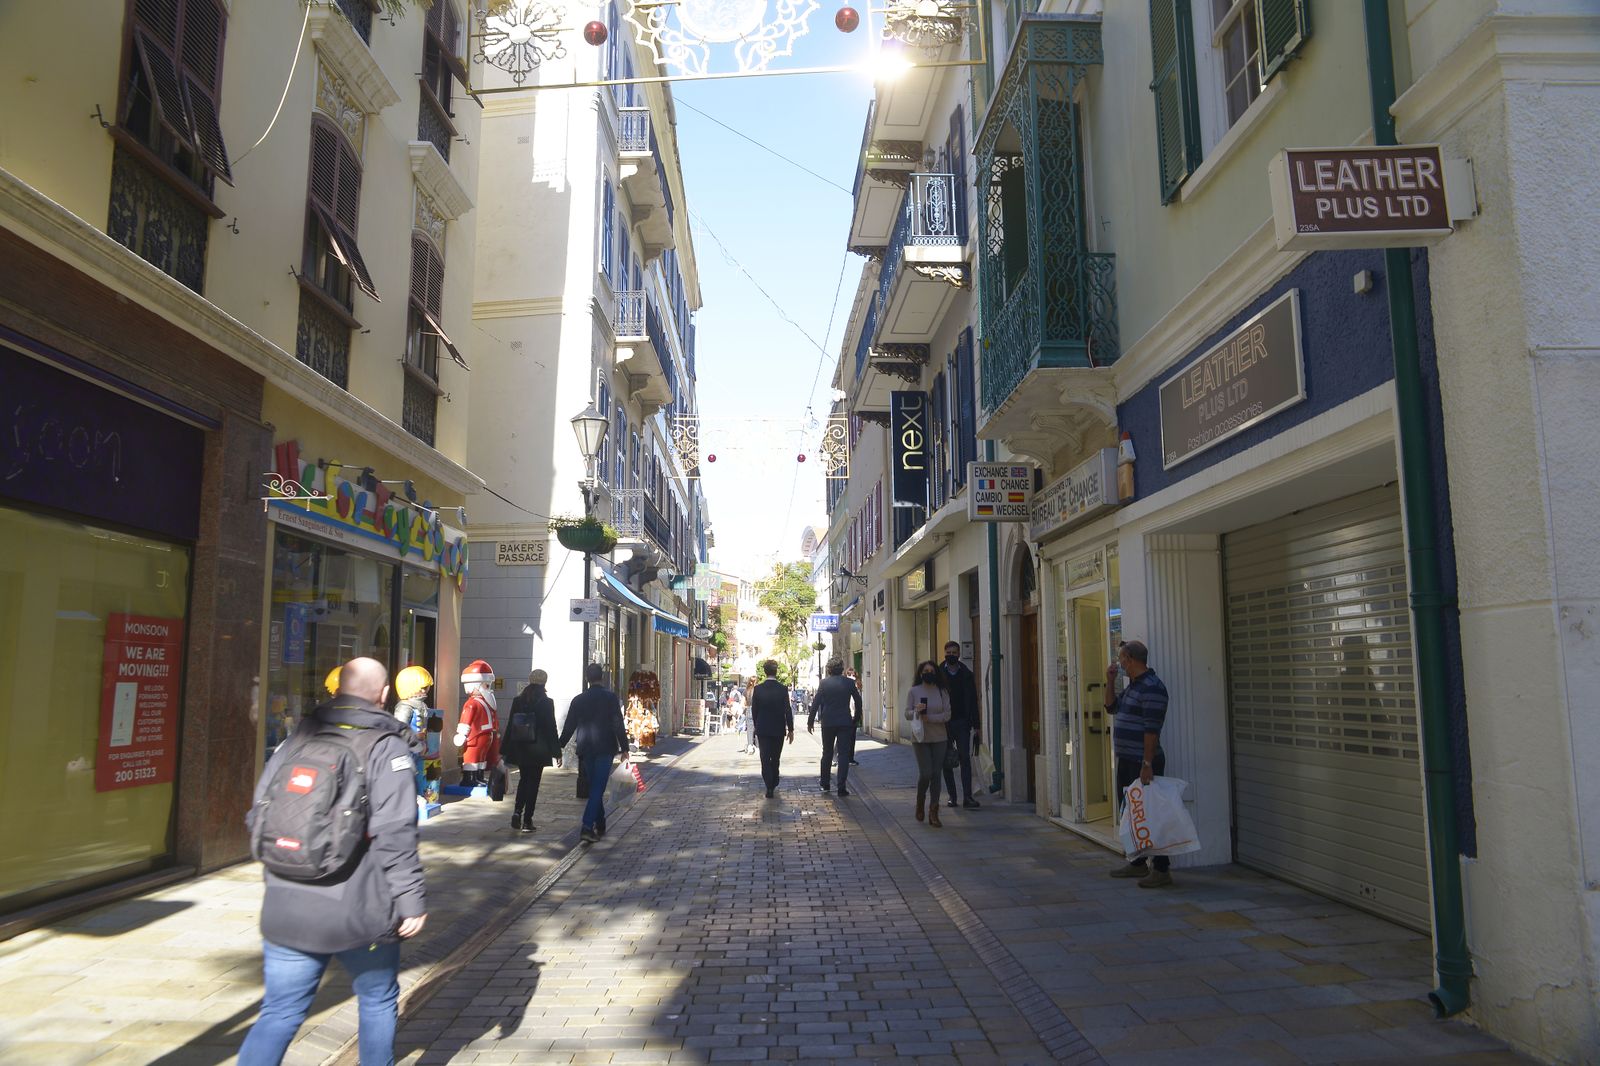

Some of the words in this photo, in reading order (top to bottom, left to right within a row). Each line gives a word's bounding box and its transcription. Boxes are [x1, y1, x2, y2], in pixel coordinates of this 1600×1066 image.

[1296, 157, 1440, 192] LEATHER
[1316, 197, 1379, 219] PLUS
[1385, 195, 1430, 218] LTD
[1300, 224, 1320, 232] 235A
[1181, 323, 1268, 409] LEATHER
[1199, 391, 1225, 424] PLUS
[1227, 378, 1249, 407] LTD
[1215, 401, 1263, 437] accessories
[900, 396, 923, 470] next
[975, 466, 1008, 477] EXCHANGE
[1001, 479, 1029, 490] CHANGE
[976, 491, 1002, 502] CAMBIO
[1032, 499, 1055, 527] BUREAU
[1058, 491, 1067, 511] DE
[1069, 472, 1099, 506] CHANGE
[278, 509, 297, 523] Ernest
[996, 505, 1029, 515] WECHSEL
[500, 544, 544, 553] BAKER'S
[498, 553, 544, 562] PASSAGE
[125, 622, 169, 636] MONSOON
[126, 646, 143, 660] WE
[145, 647, 165, 660] ARE
[118, 663, 169, 677] MOVING!!!
[115, 770, 133, 782] 200
[134, 767, 157, 779] 51323
[1129, 787, 1154, 850] CARLOS
